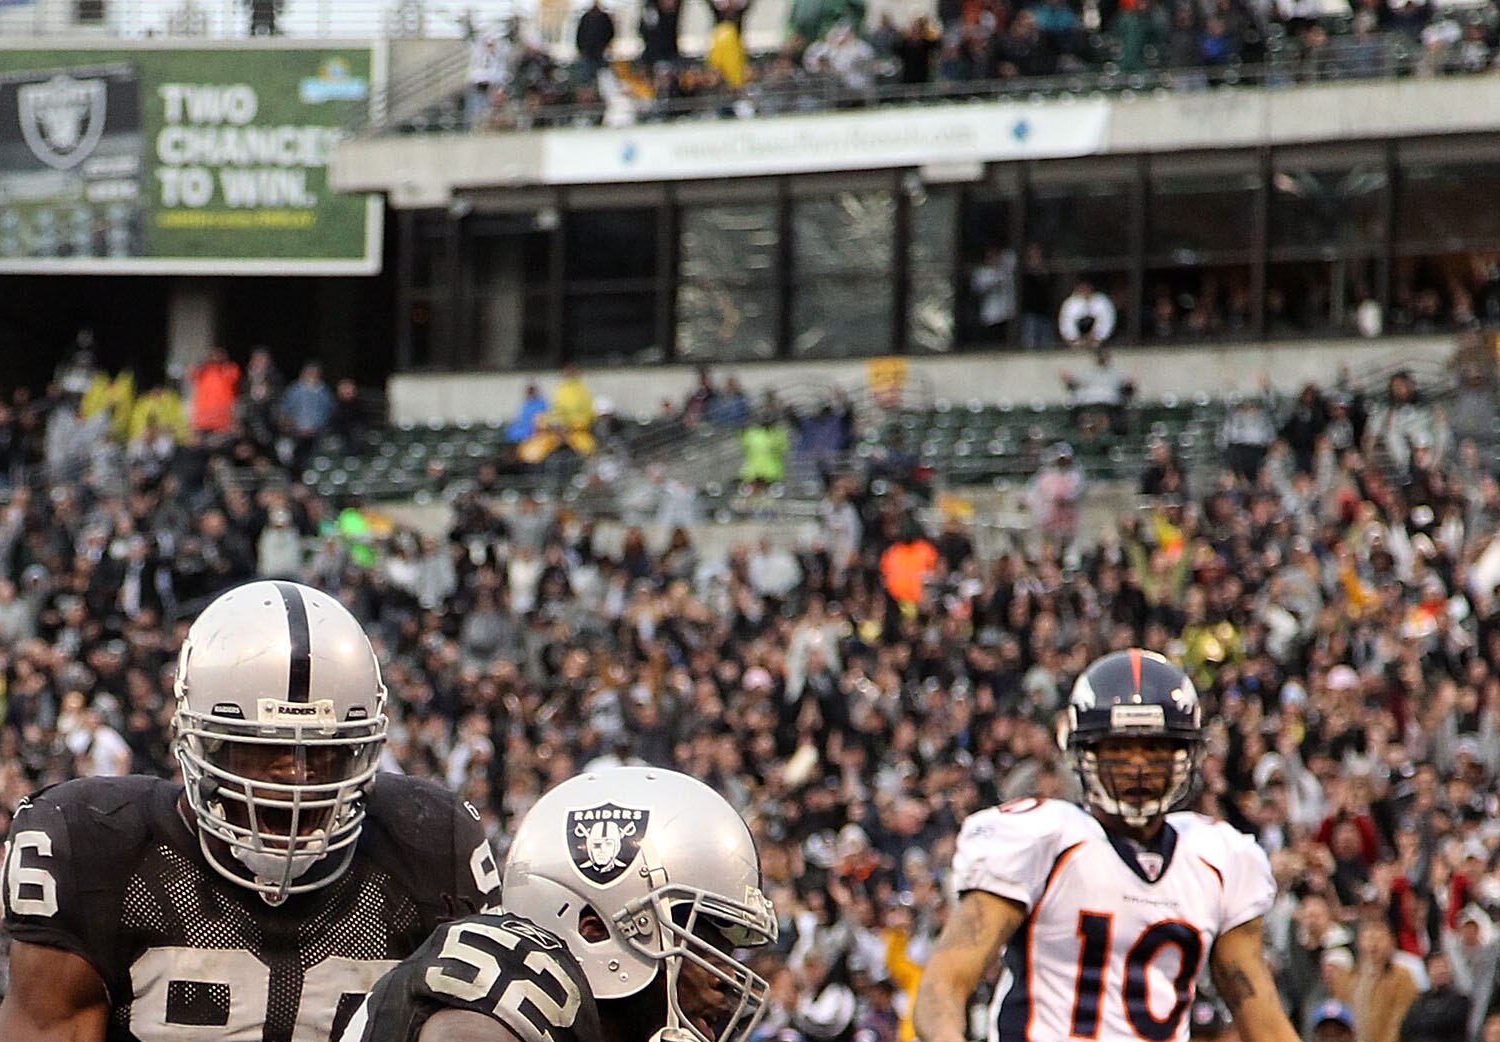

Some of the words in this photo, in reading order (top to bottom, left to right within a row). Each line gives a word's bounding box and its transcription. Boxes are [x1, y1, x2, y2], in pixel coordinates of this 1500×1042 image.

[156, 83, 258, 124] TWO
[155, 167, 213, 208] TO
[220, 167, 318, 208] WIN.
[278, 706, 317, 716] RAIDERS
[573, 809, 643, 821] RAIDERS
